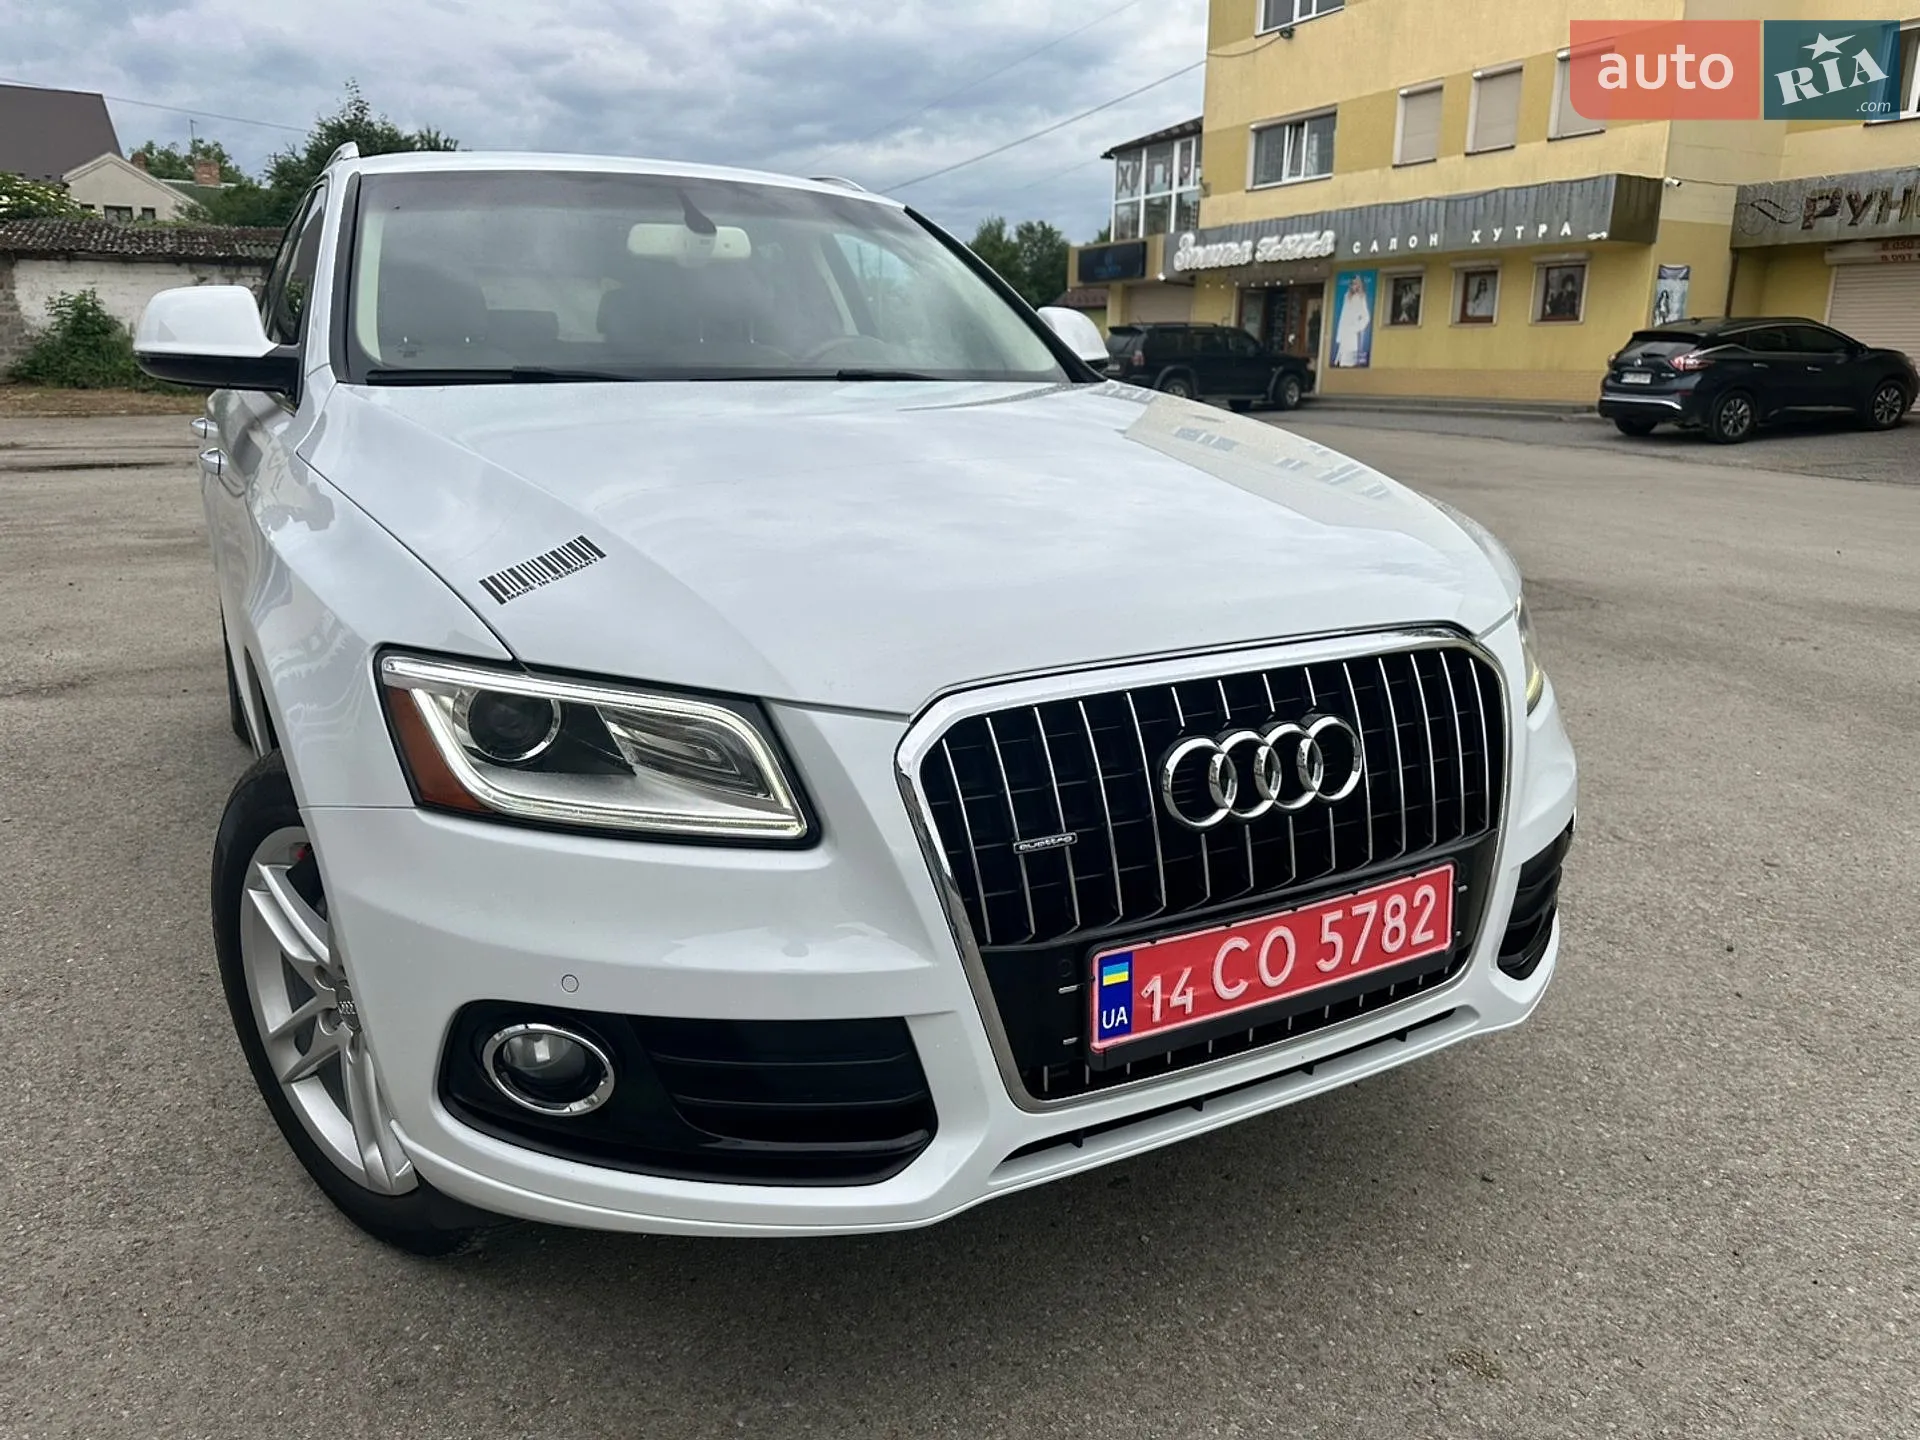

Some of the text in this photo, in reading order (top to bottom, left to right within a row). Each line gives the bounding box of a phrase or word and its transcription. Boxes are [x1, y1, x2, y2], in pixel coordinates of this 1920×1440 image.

[1801, 184, 1920, 230] РУН
[1353, 221, 1572, 254] САЛОН ХУТРА
[506, 557, 598, 600] MADE IN GERMANY
[1141, 884, 1437, 1023] 14 CO 5782
[1102, 1007, 1129, 1029] UA
